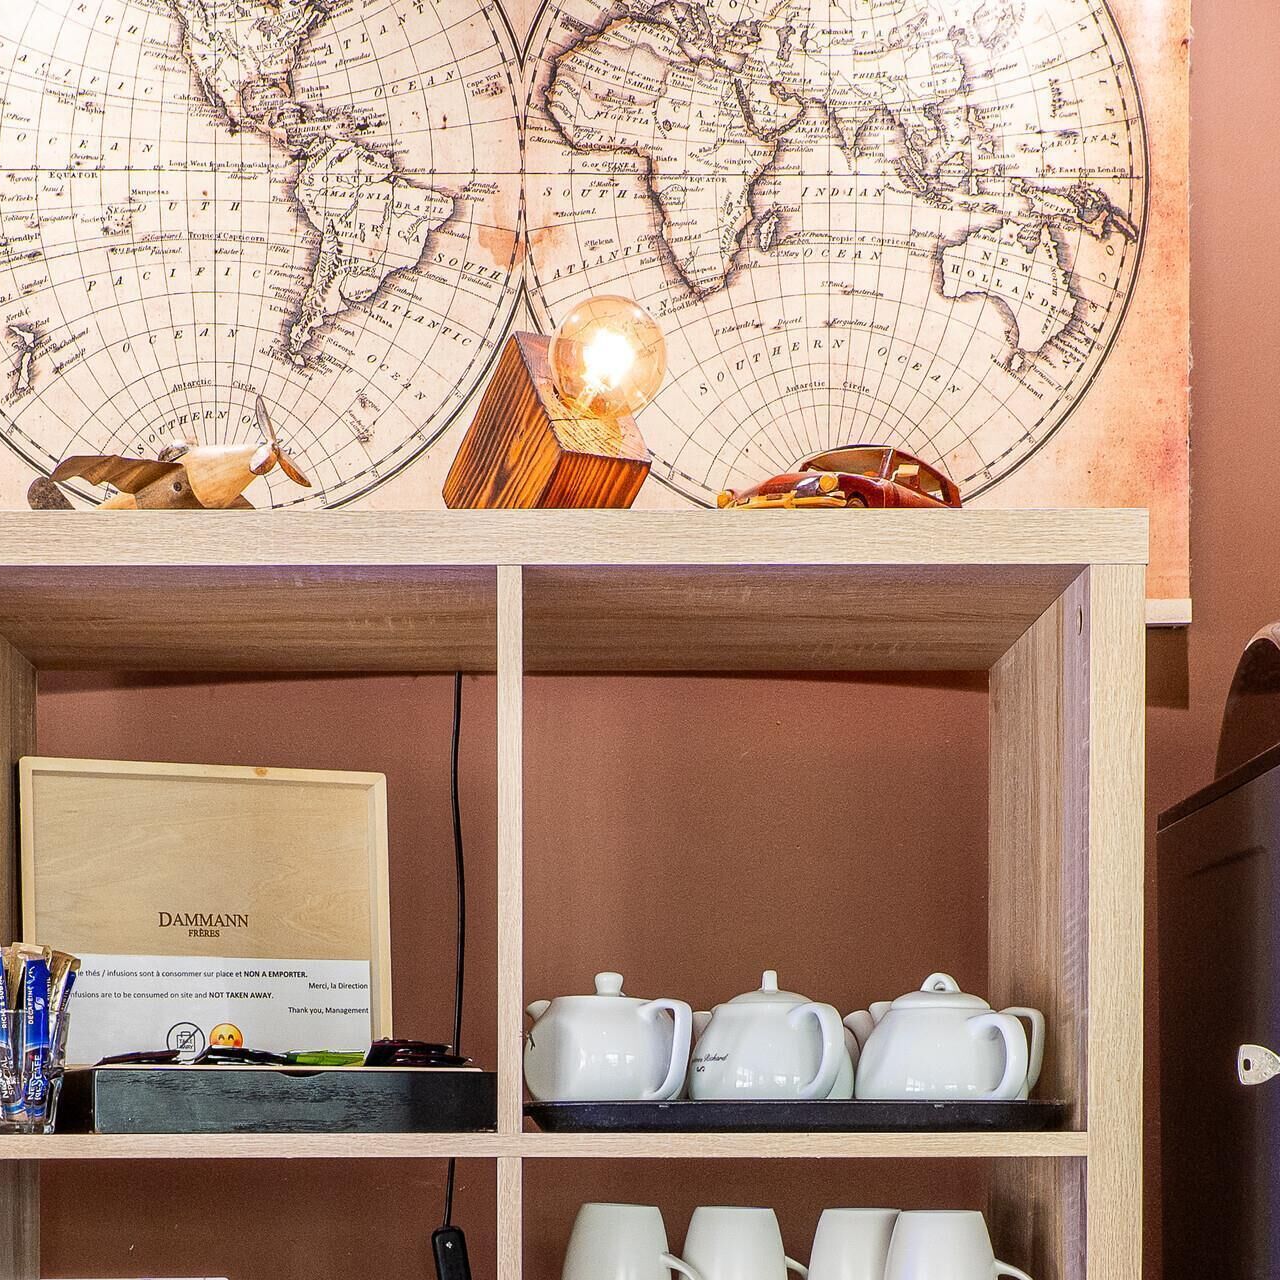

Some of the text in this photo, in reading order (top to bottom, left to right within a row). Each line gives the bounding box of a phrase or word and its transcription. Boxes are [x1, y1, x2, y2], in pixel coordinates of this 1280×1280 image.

[300, 83, 330, 95] Bahama
[374, 70, 455, 98] OCEAN
[190, 161, 208, 169] West
[225, 161, 254, 169] London
[1058, 166, 1077, 174] East
[1097, 165, 1126, 174] London
[48, 170, 99, 179] EQUATOR
[688, 176, 728, 184] EQUATOR
[320, 188, 392, 201] AMAZONIA
[542, 187, 628, 199] SOUTH
[801, 186, 886, 198] INDIAN
[394, 201, 445, 214] BRAZIL
[188, 230, 214, 240] Tropic
[222, 232, 266, 242] Capricorn
[552, 240, 656, 281] ATLANTIC
[803, 247, 883, 261] OCEAN
[433, 251, 504, 281] SOUTH
[981, 251, 1033, 273] NEW
[87, 266, 262, 292] PACIFIC
[950, 263, 1050, 308] HOLLAND
[376, 299, 474, 348] ATLANTIC
[122, 327, 240, 354] OCEAN
[698, 338, 846, 397] SOUTHERN
[876, 345, 962, 394] OCEAN
[365, 353, 427, 401] OCEAN
[171, 378, 257, 393] Antarctic Circle
[785, 380, 870, 394] Antarctic Circle
[136, 410, 229, 455] SOUTHERN
[158, 911, 249, 928] DAMMANN
[188, 928, 220, 938] FRÈRES
[106, 969, 138, 977] infusions
[139, 970, 154, 978] sont
[215, 971, 234, 979] place
[268, 971, 308, 979] EMPORTER.
[308, 982, 369, 991] Merci, la Direction
[70, 991, 100, 999] nfusions
[132, 991, 168, 999] consumed
[287, 1006, 369, 1016] Thank you, Management
